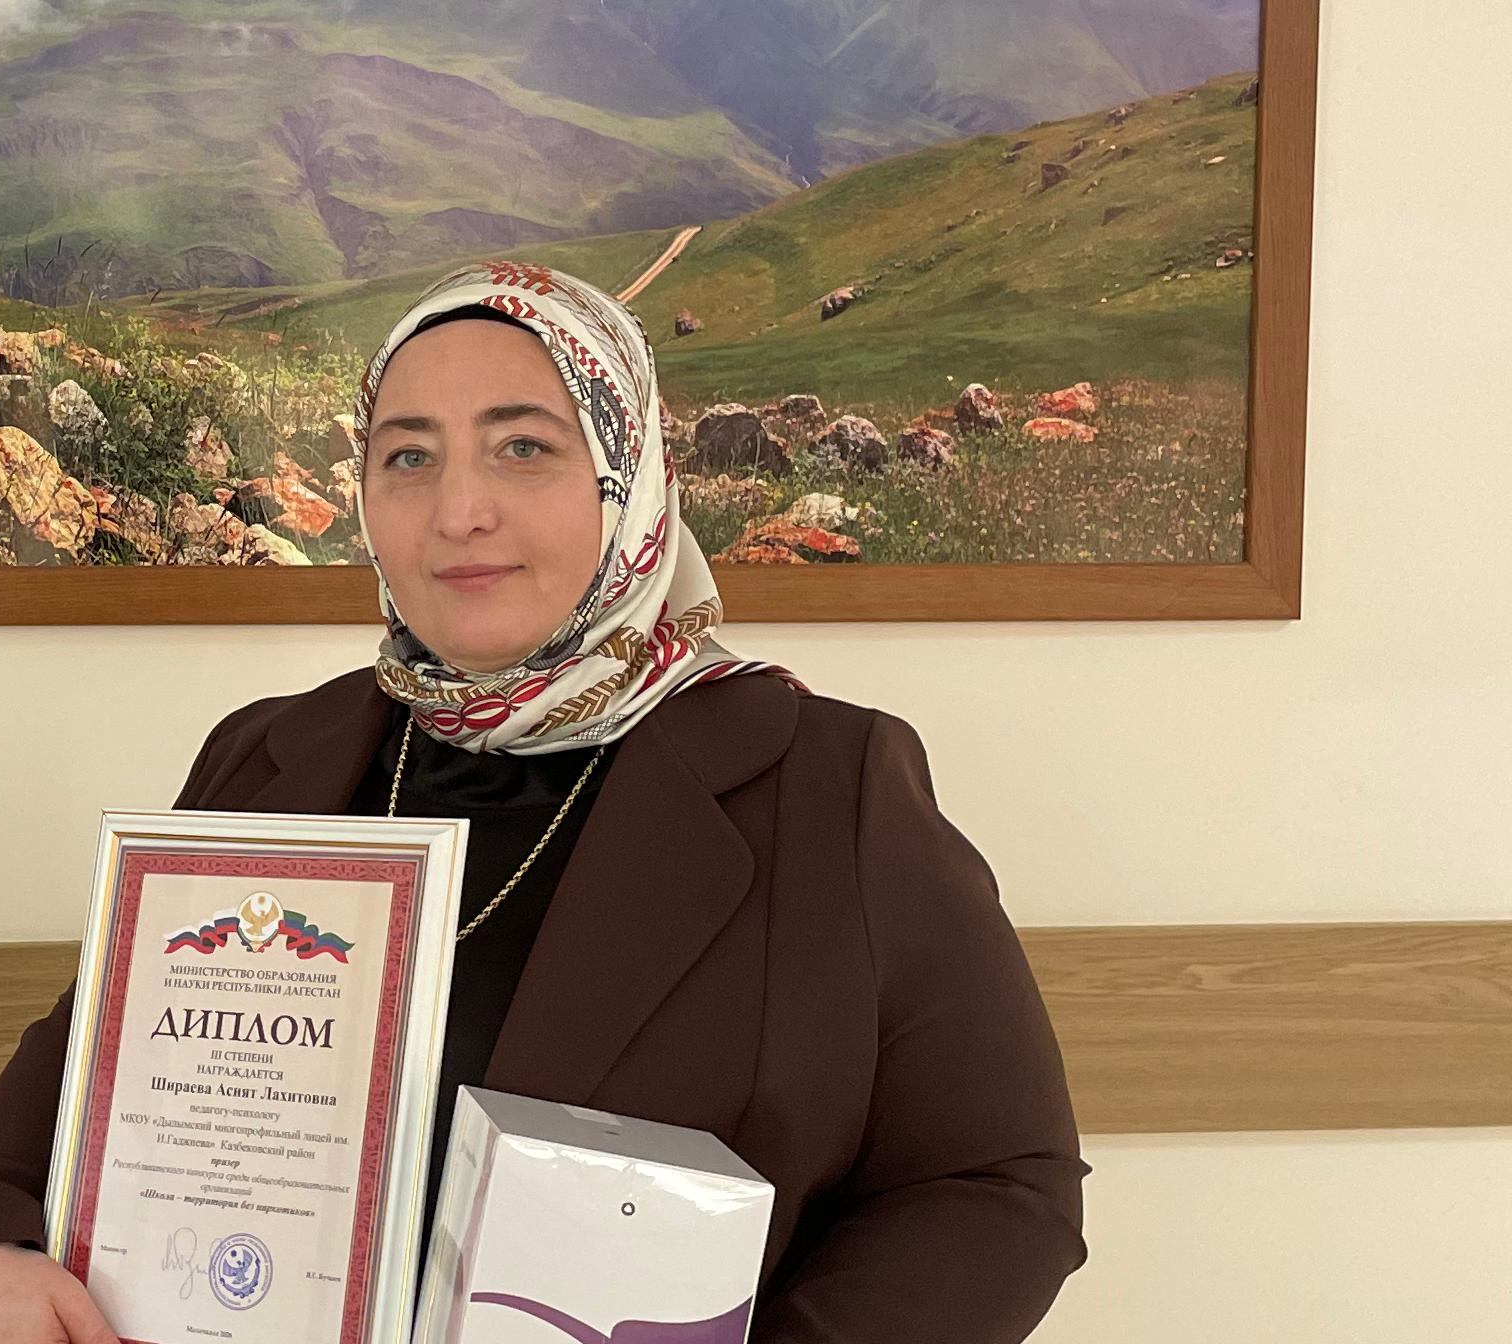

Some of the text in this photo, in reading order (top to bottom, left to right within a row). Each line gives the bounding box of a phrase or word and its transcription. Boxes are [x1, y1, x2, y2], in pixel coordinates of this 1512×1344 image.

[169, 964, 337, 985] МИНИСТЕРСТВО ОБРАЗОВАНИЯ
[163, 977, 341, 999] И НАУКИ РЕСПУБЛИКИ ДАГЕСТАН
[150, 1006, 336, 1049] ДИПЛОМ
[224, 1051, 274, 1064] СТЕПЕНИ
[196, 1064, 284, 1081] НАГРАЖДАЕТСЯ
[151, 1076, 337, 1107] Шираева Асият Лахитовна
[189, 1104, 280, 1122] педагогу-психологу
[119, 1112, 150, 1125] МКОУ
[214, 1123, 301, 1140] многопрофильный
[303, 1132, 332, 1144] лицей
[220, 1139, 285, 1157] Казбековский
[286, 1147, 316, 1160] район
